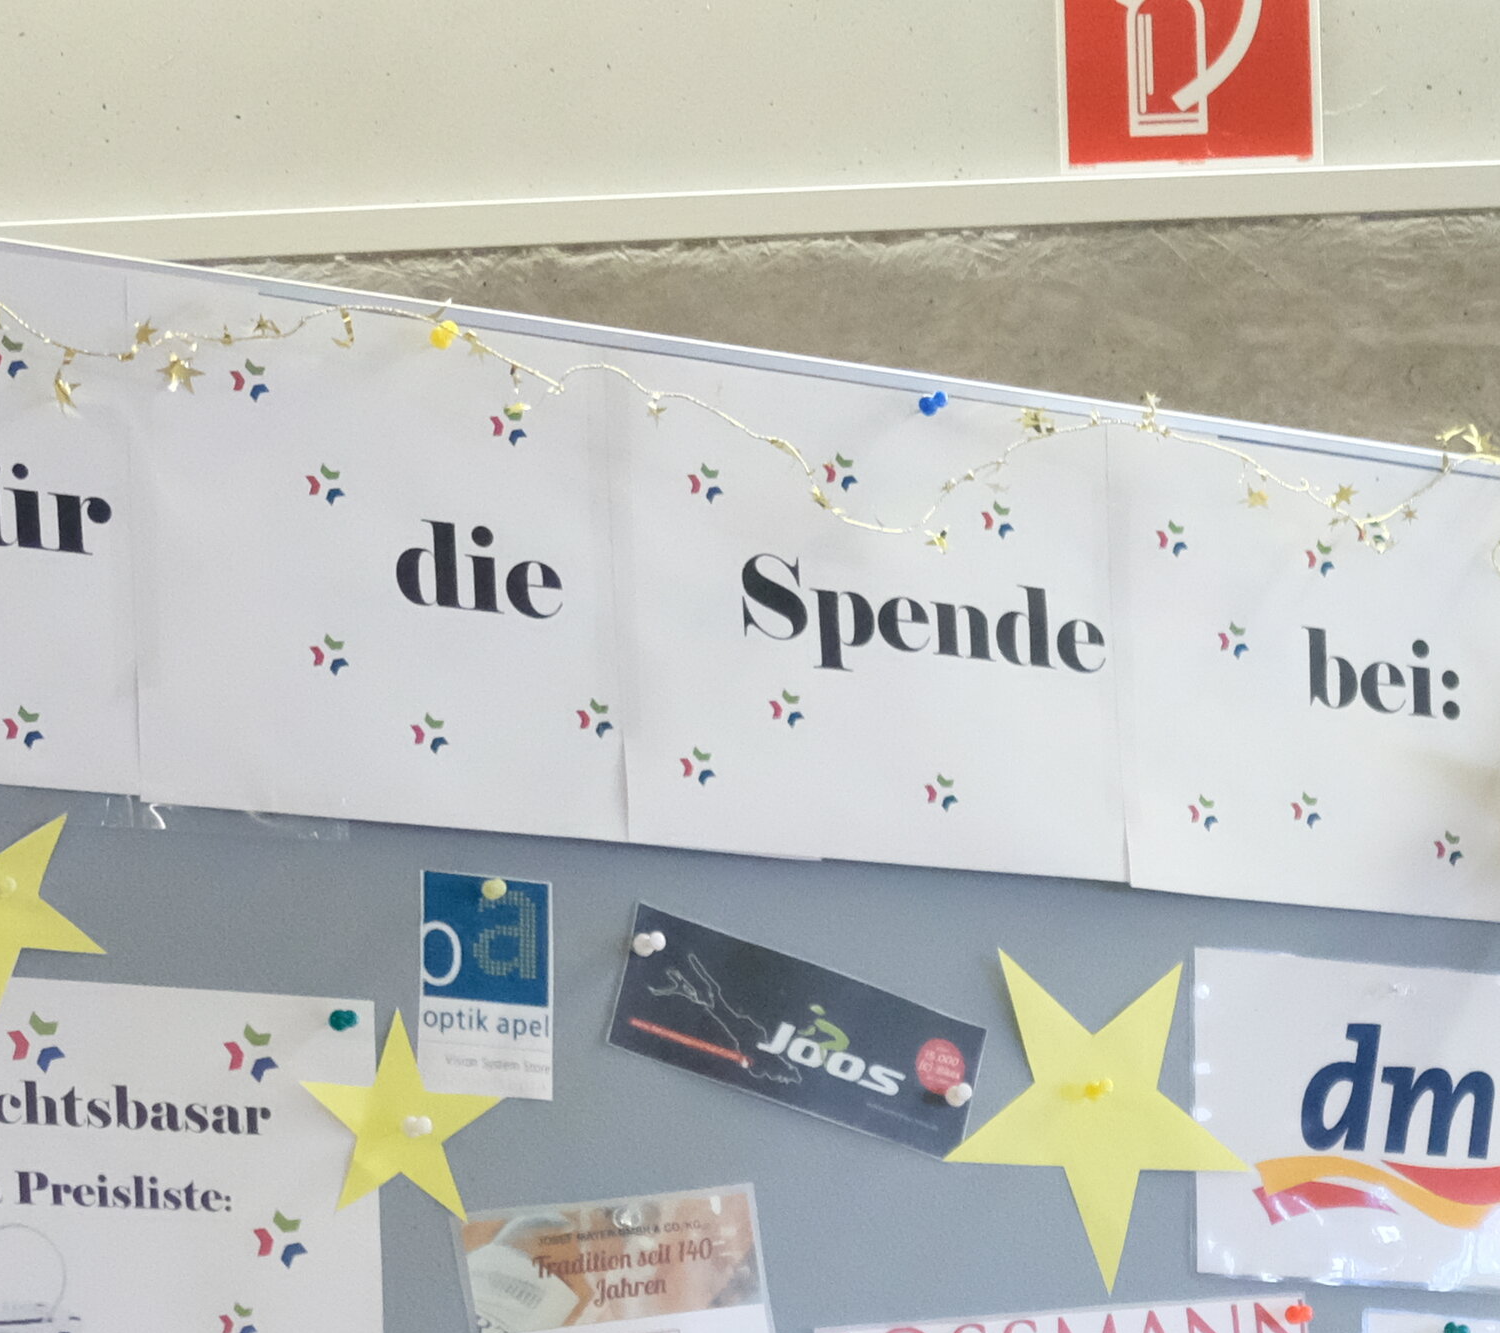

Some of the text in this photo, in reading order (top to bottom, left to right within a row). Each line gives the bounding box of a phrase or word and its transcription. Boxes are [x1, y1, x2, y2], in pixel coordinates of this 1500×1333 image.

[394, 519, 565, 620] die
[741, 552, 1108, 674] Spende
[1303, 625, 1461, 721] bei:
[423, 1008, 489, 1035] optik
[1300, 1022, 1496, 1160] dm
[14, 1169, 234, 1214] Preisliste:
[532, 1238, 714, 1278] Tradition seit 140
[593, 1277, 667, 1307] Jahren
